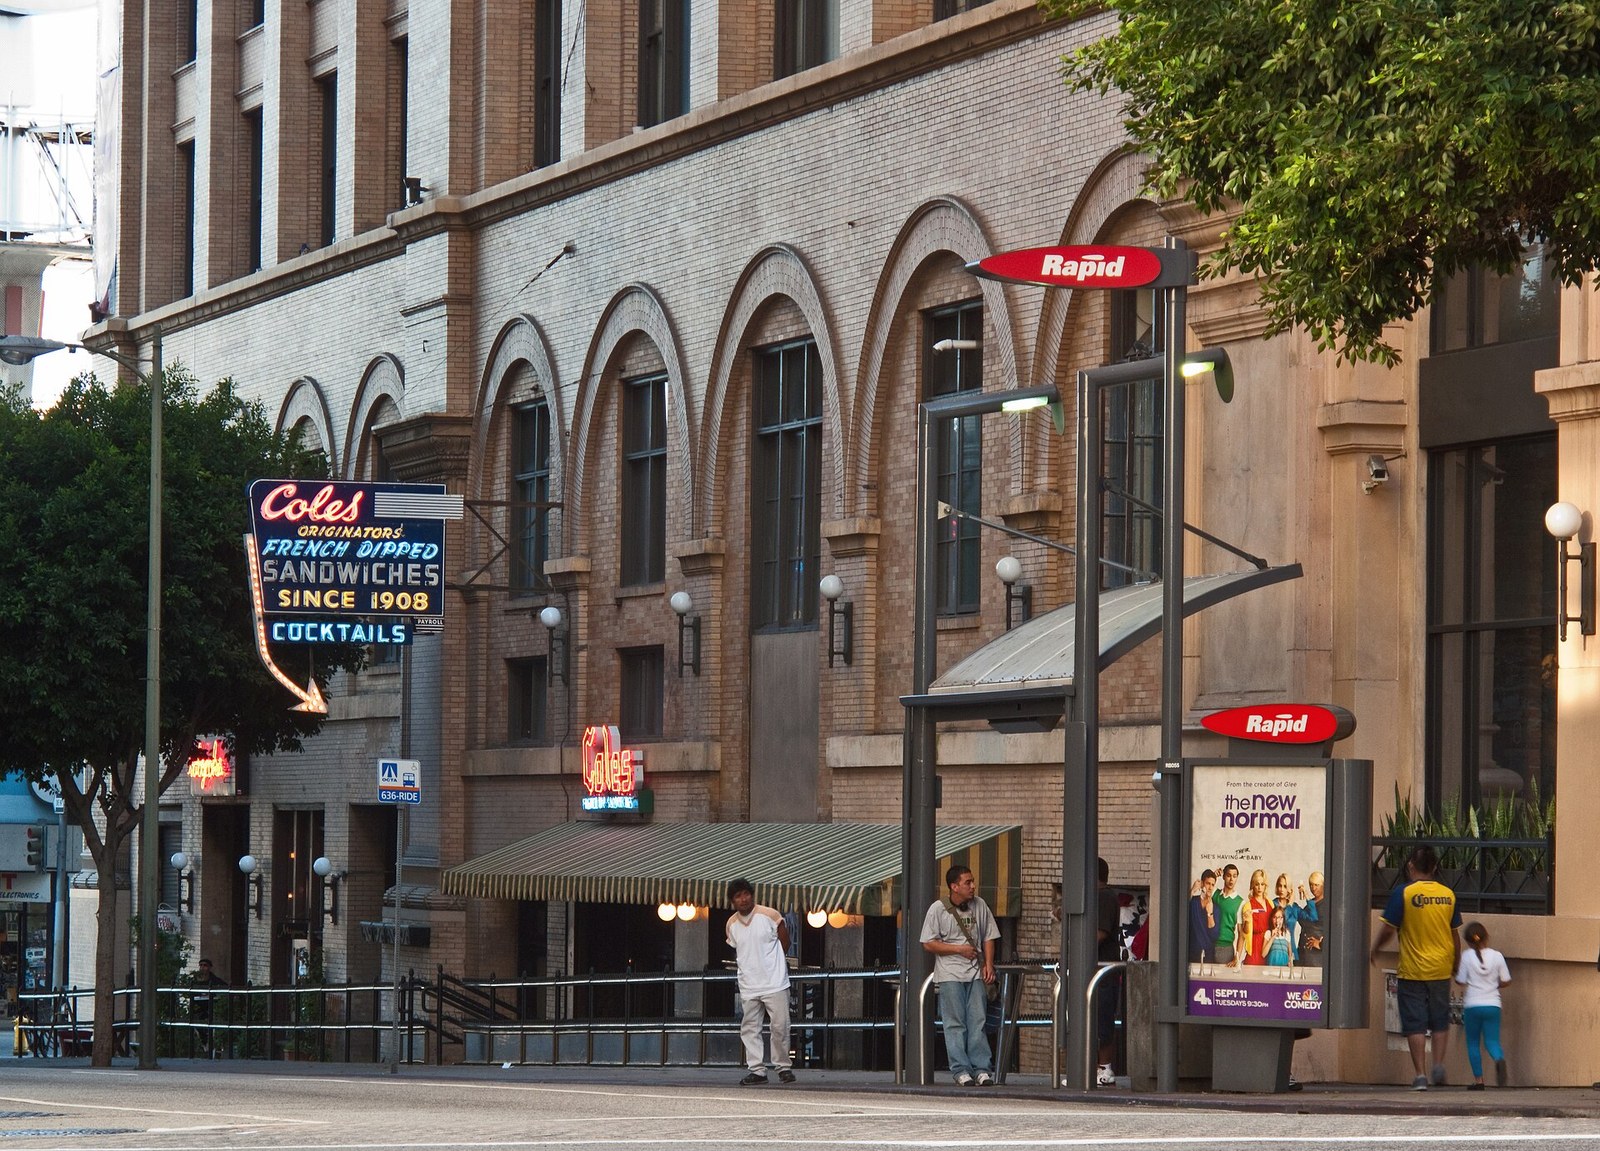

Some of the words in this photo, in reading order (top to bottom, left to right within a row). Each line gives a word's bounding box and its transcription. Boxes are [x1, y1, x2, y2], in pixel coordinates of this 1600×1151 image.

[1041, 254, 1126, 281] Rapid
[260, 483, 365, 522] Coles
[297, 525, 403, 539] ORIGINATORS
[262, 539, 351, 558] FRENCH
[356, 540, 439, 560] DIPPED
[263, 560, 440, 587] SANDWICHES
[278, 589, 356, 609] SINCE
[371, 591, 429, 611] 1908
[272, 622, 406, 644] COCKTAILS
[1246, 714, 1309, 737] Rapid
[381, 791, 418, 801] 636-RIDE
[1225, 794, 1251, 810] the
[1252, 794, 1297, 811] new
[1221, 809, 1301, 830] normal
[1411, 893, 1452, 909] Corona
[1215, 989, 1239, 998] SEPT
[1239, 989, 1248, 999] 11
[1286, 991, 1302, 1001] WE
[1284, 1000, 1322, 1010] COMEDY
